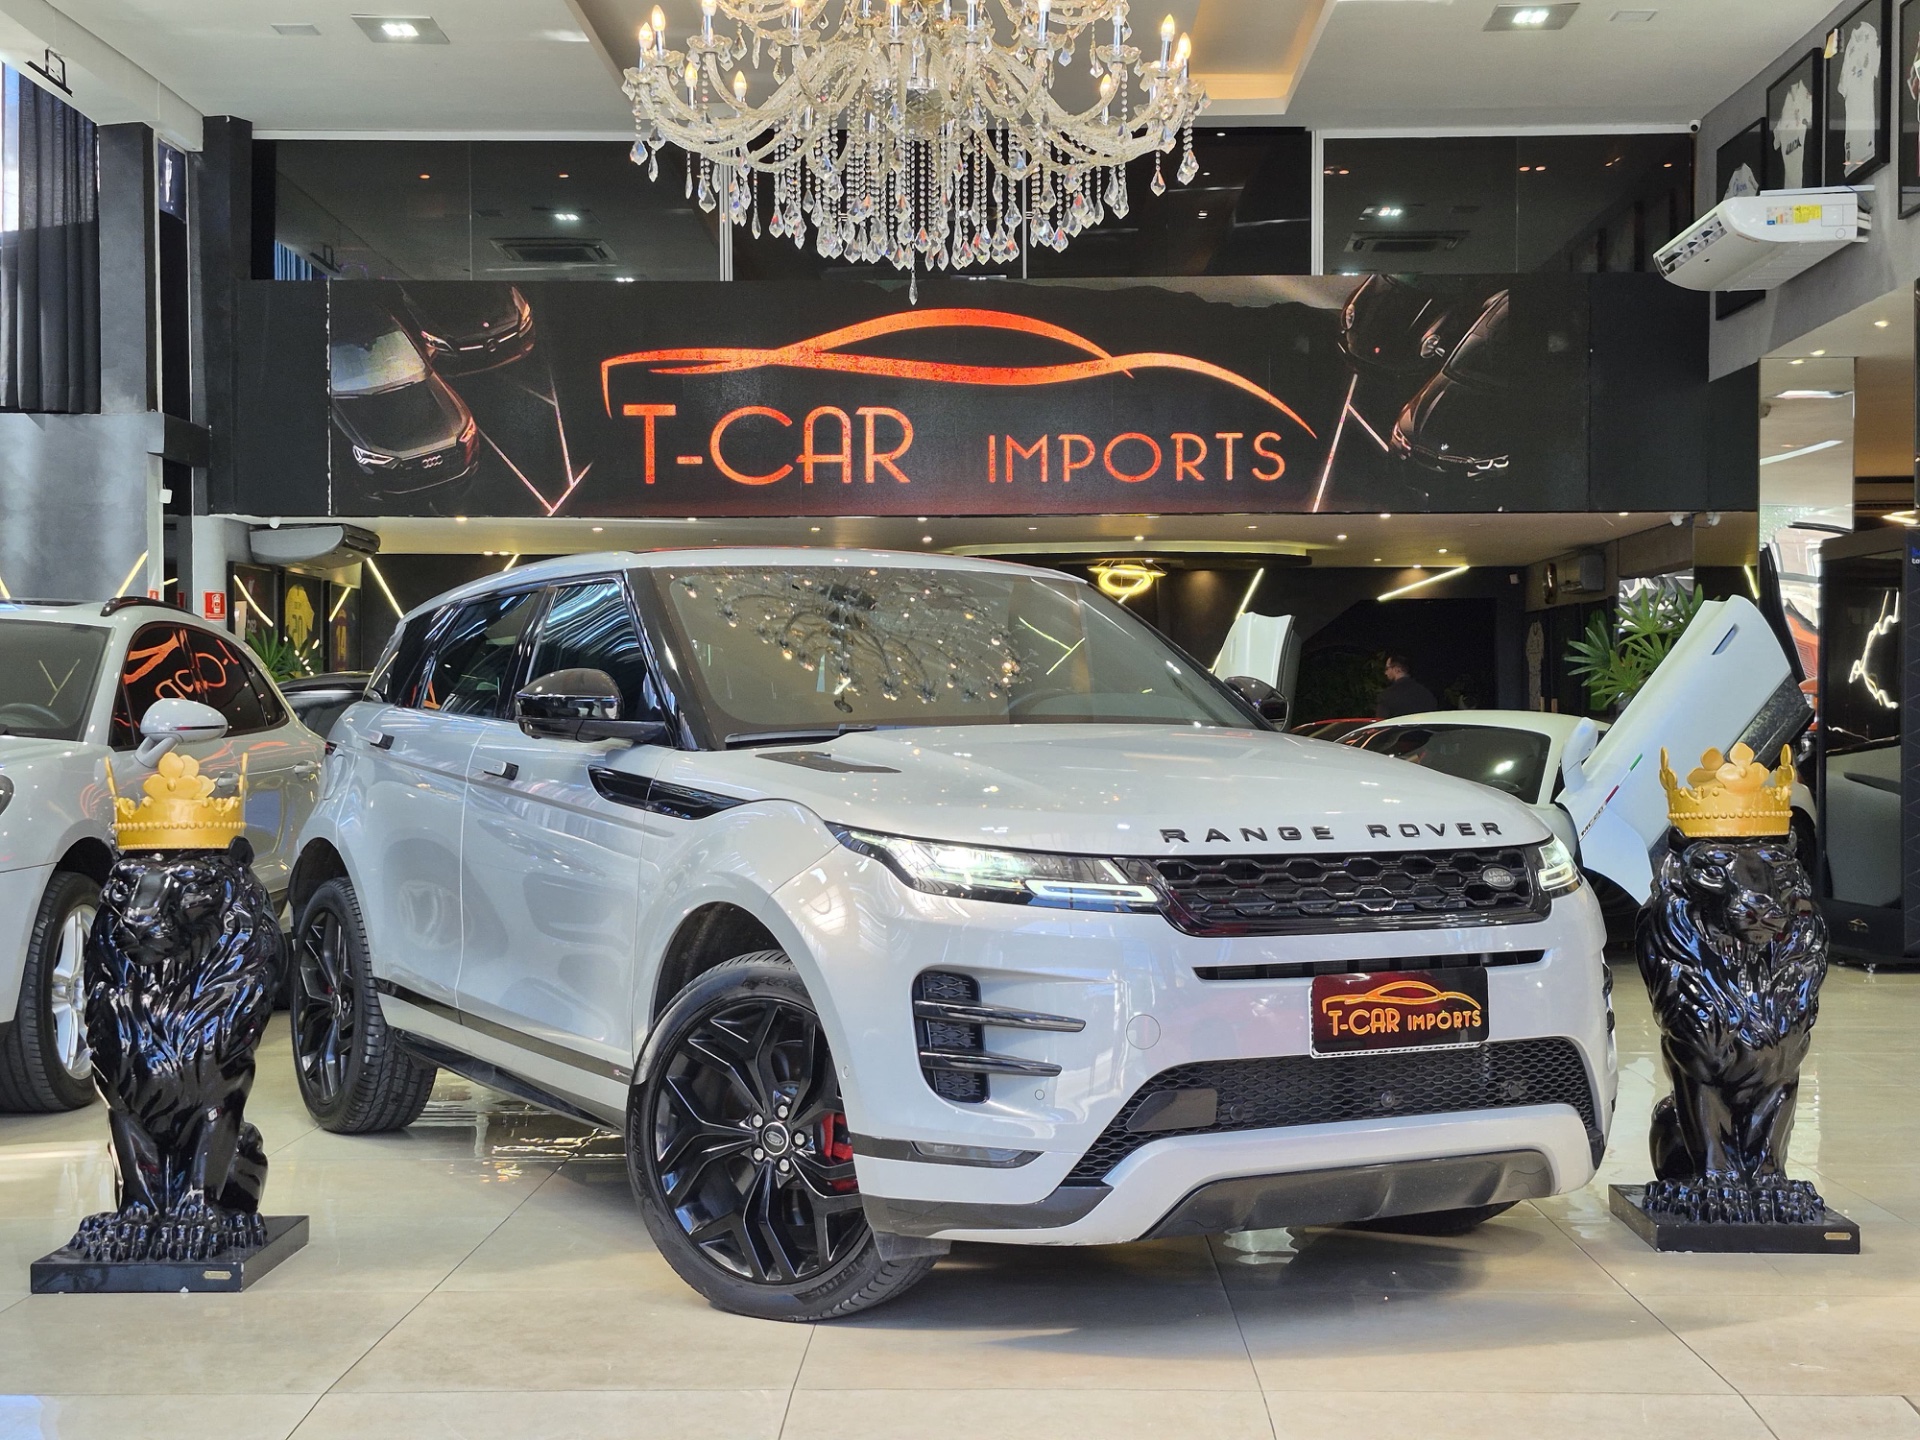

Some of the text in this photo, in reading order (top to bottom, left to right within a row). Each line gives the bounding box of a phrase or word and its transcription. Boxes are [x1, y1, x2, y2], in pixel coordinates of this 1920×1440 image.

[623, 403, 1286, 485] T-CAR IMPORTS
[1159, 822, 1503, 843] RANGE ROVER
[1328, 1008, 1482, 1036] T-CAR IMPORTS
